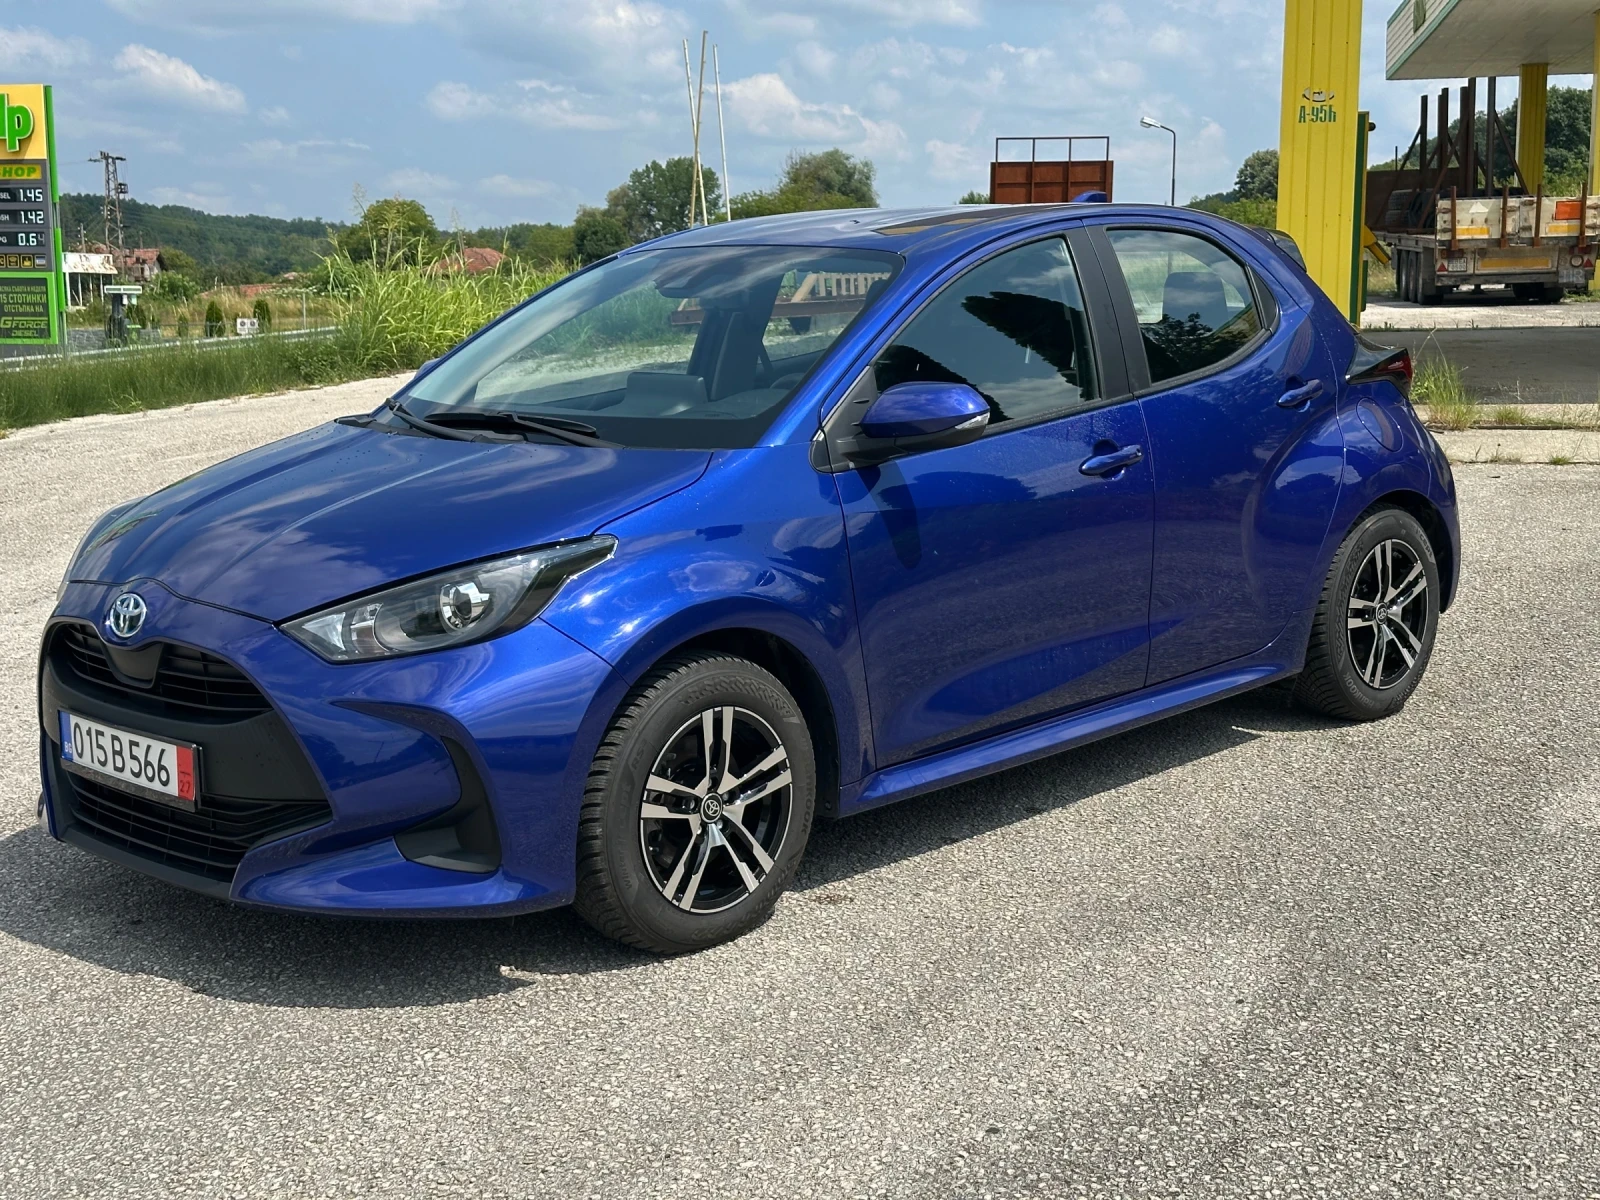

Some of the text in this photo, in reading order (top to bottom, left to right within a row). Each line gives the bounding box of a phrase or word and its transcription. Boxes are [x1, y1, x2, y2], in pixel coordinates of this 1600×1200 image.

[0, 166, 37, 178] HOP
[19, 188, 43, 202] 1.45
[20, 211, 44, 224] 1.42
[17, 232, 45, 246] 0.64
[0, 293, 47, 303] 15 СТОТИНКИ
[4, 304, 44, 312] ОТСТЪПКА НА
[11, 329, 39, 337] DIESEL
[64, 741, 73, 753] BG
[73, 722, 170, 787] 015B566
